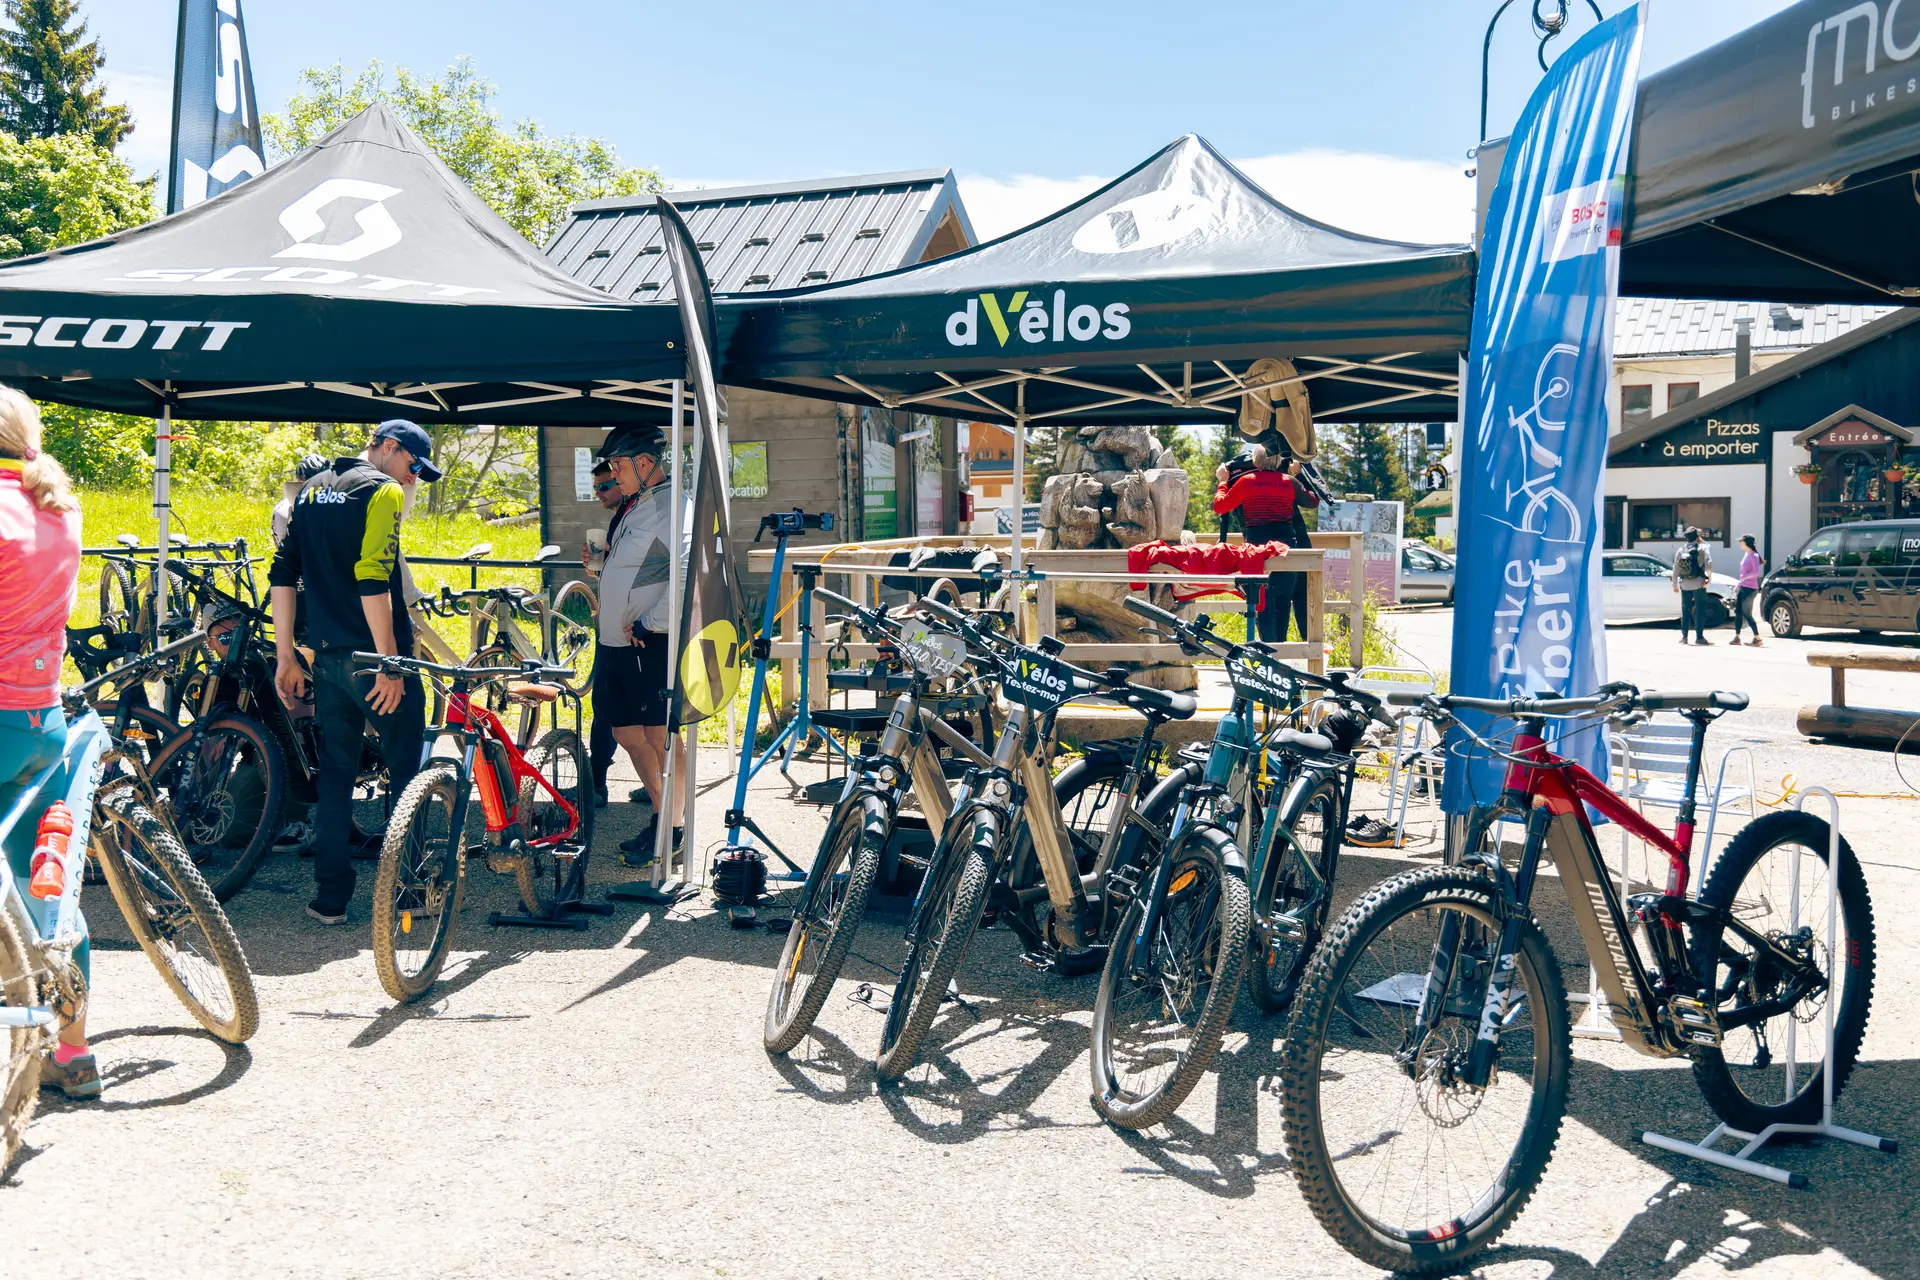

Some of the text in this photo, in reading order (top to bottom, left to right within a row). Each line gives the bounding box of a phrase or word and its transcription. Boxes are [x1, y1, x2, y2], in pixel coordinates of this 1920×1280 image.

[1831, 78, 1917, 120] BIKES
[104, 266, 501, 297] SCOTT
[0, 315, 252, 351] SCOTT
[1707, 419, 1760, 437] Pizzas
[1830, 432, 1879, 443] Entrée
[1663, 440, 1760, 459] à emporter
[931, 655, 958, 675] TEST
[1005, 675, 1060, 703] Testez-moi
[1422, 888, 1490, 904] MAXXIS
[1585, 880, 1643, 1001] MOUSTACHE
